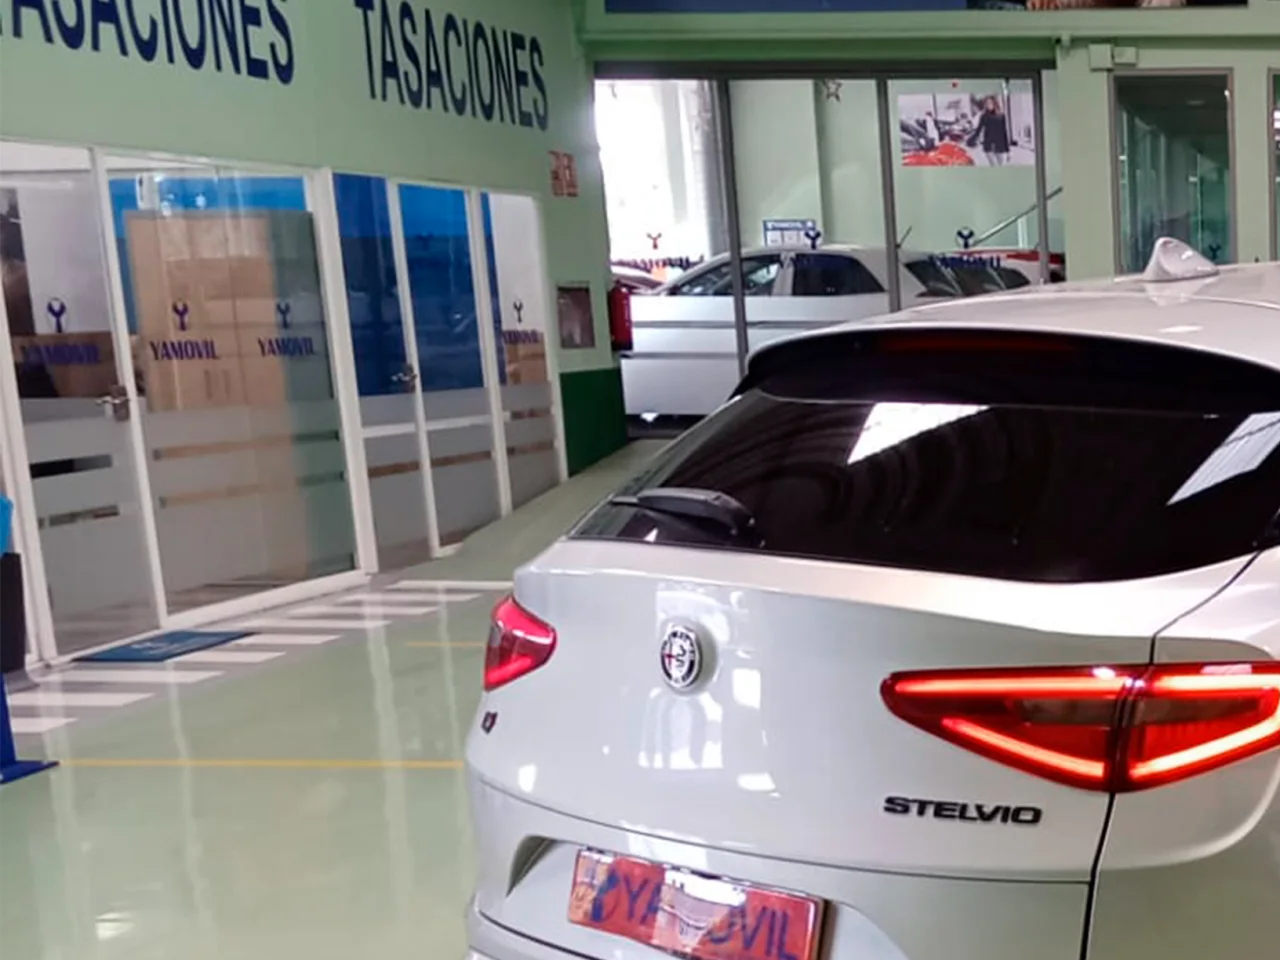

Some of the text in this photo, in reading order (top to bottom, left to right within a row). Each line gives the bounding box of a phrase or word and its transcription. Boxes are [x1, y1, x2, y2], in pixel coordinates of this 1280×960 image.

[0, 0, 294, 85] CIONES
[355, 0, 548, 131] TASACIONES
[150, 339, 220, 361] YAMOVIL
[883, 796, 1042, 824] STELVIO
